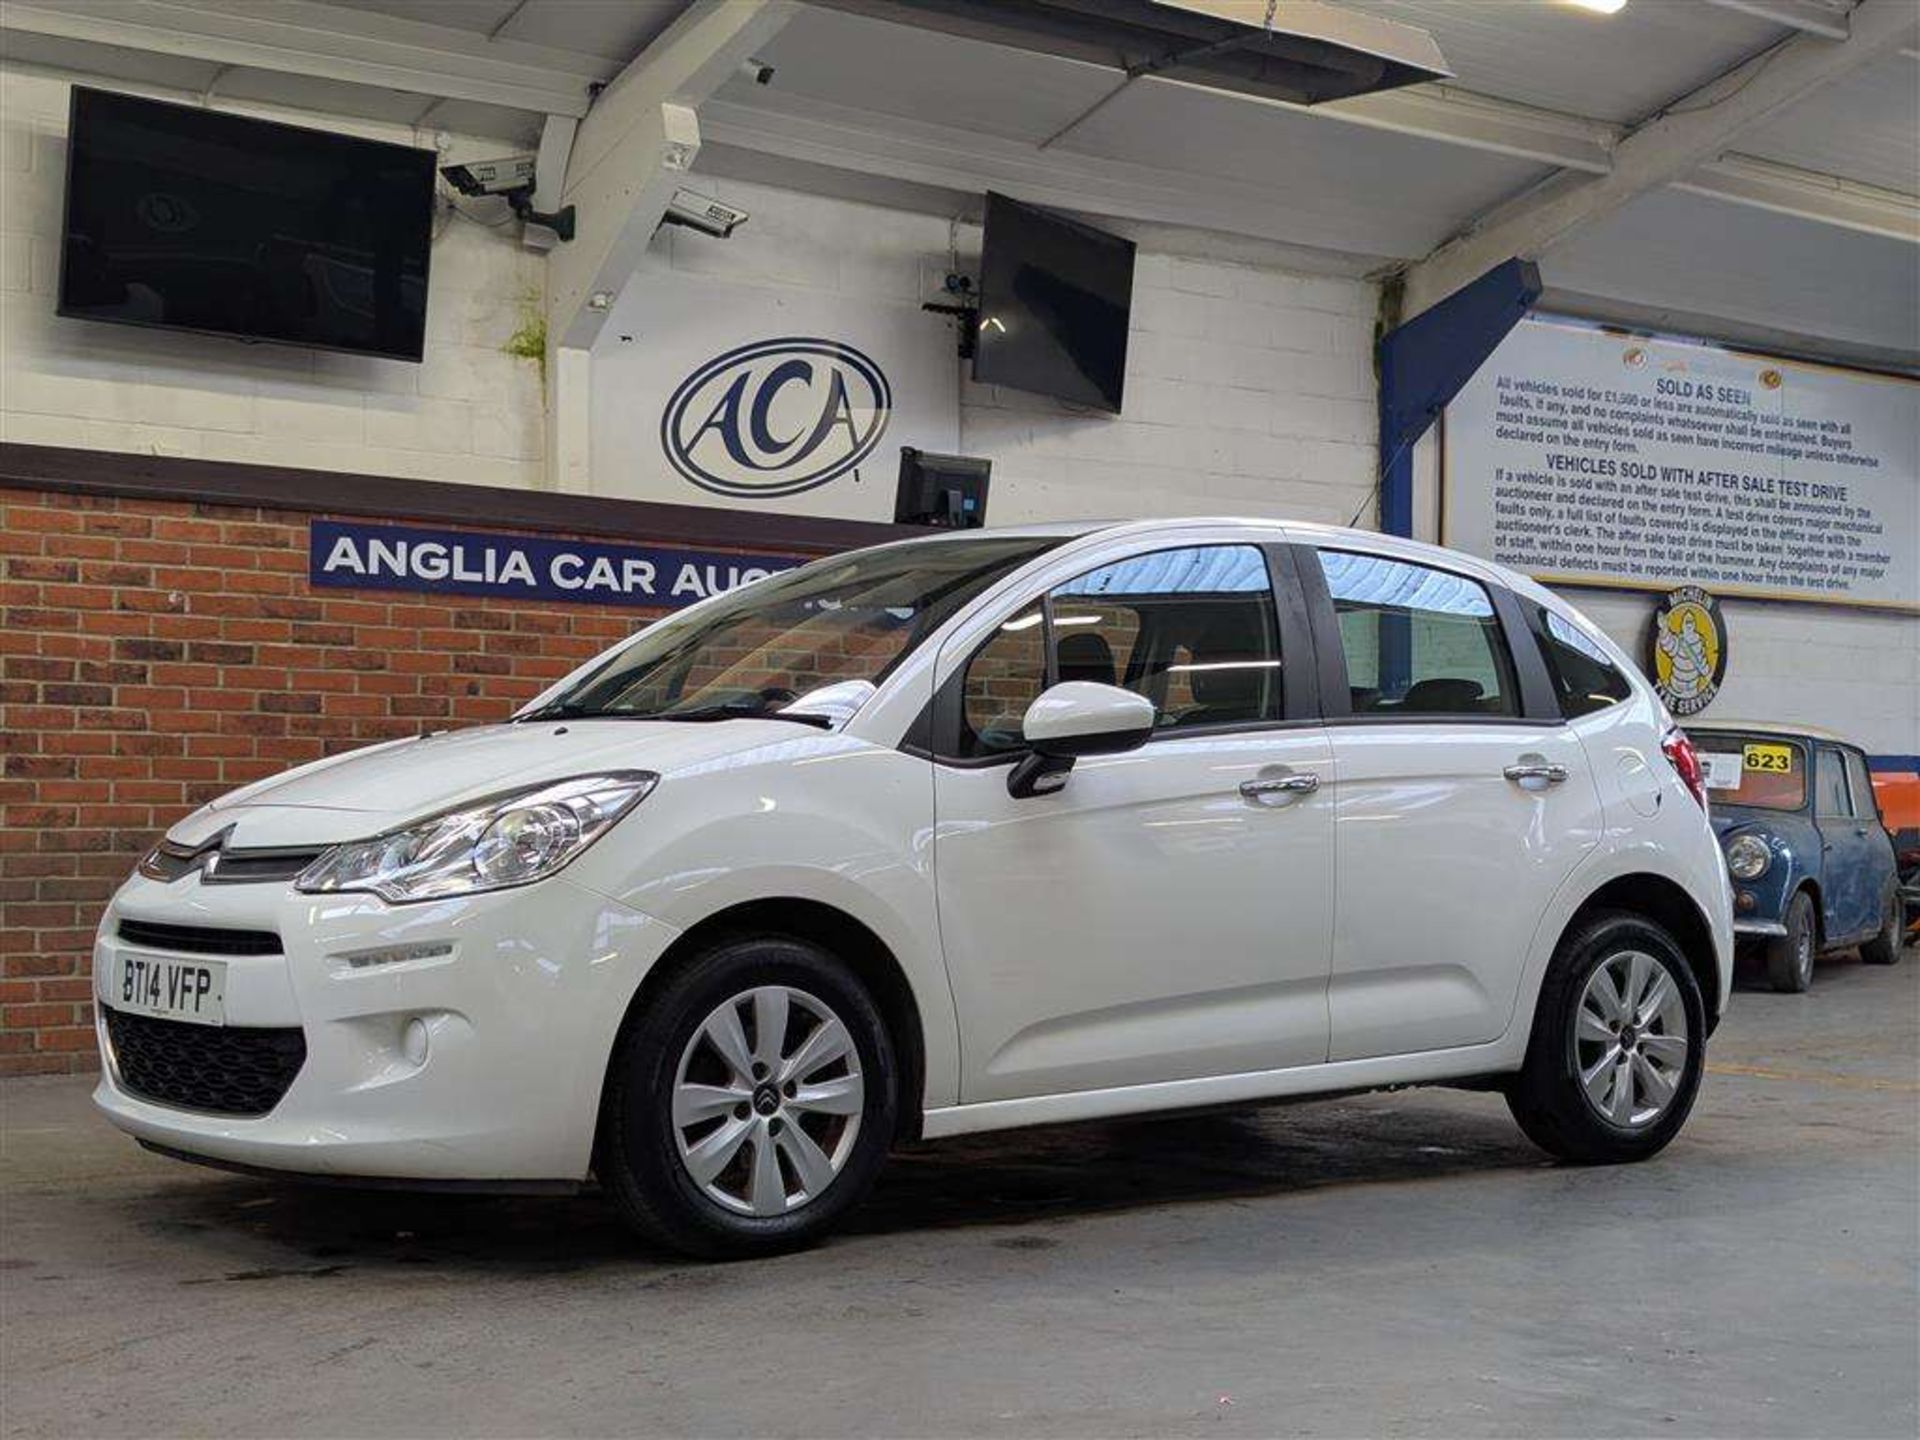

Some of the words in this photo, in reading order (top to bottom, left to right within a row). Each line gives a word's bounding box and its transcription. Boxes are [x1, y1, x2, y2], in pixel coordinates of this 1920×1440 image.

[1514, 380, 1557, 395] vehicles
[1561, 386, 1584, 399] sold
[1587, 388, 1601, 401] for
[1640, 398, 1651, 407] or
[1654, 397, 1673, 410] less
[1676, 403, 1691, 413] are
[1656, 377, 1692, 397] SOLD
[1696, 385, 1714, 401] AS
[1717, 387, 1751, 405] SEEN
[685, 360, 858, 471] ACA
[1496, 412, 1523, 423] must
[1526, 415, 1567, 429] assume
[1571, 419, 1584, 431] all
[1586, 422, 1629, 436] vehicles
[1633, 428, 1654, 439] sold
[1656, 432, 1668, 441] as
[1670, 434, 1694, 444] seen
[1697, 434, 1718, 447] have
[1721, 437, 1763, 453] incorrect
[1570, 403, 1590, 416] and
[1594, 407, 1606, 418] no
[1609, 409, 1664, 425] complaints
[1751, 425, 1761, 437] be
[1496, 425, 1543, 442] declared
[1546, 434, 1559, 444] on
[1563, 433, 1580, 446] the
[1582, 437, 1609, 452] entry
[1496, 468, 1503, 480] If
[1515, 472, 1553, 485] vehicle
[1556, 475, 1566, 486] is
[1569, 477, 1592, 489] sold
[1594, 480, 1616, 491] with
[1620, 484, 1631, 493] an
[1634, 483, 1656, 496] after
[1660, 487, 1680, 498] sale
[1683, 488, 1702, 500] test
[1734, 494, 1750, 505] this
[1779, 498, 1790, 509] be
[1546, 454, 1615, 476] VEHICLES
[1620, 462, 1656, 480] SOLD
[1660, 466, 1693, 484] WITH
[1696, 470, 1738, 489] AFTER
[1742, 476, 1774, 493] SALE
[1778, 480, 1808, 497] TEST
[1812, 484, 1846, 501] DRIVE
[1496, 487, 1552, 501] auctioneer
[1556, 492, 1574, 503] and
[1578, 493, 1624, 508] declared
[1627, 501, 1638, 510] on
[1642, 500, 1657, 511] the
[1660, 503, 1685, 517] entry
[1725, 508, 1743, 520] test
[1746, 510, 1768, 522] drive
[1772, 515, 1803, 526] covers
[1496, 500, 1525, 515] faults
[1566, 507, 1583, 520] full
[1586, 509, 1601, 522] list
[1604, 511, 1615, 523] of
[1618, 512, 1646, 526] faults
[1649, 518, 1688, 530] covered
[1690, 519, 1699, 531] is
[1702, 520, 1747, 537] displayed
[1751, 525, 1759, 537] in
[1762, 526, 1776, 538] the
[1495, 535, 1505, 546] of
[1540, 539, 1571, 551] within
[1574, 543, 1594, 553] one
[1597, 543, 1620, 555] hour
[1623, 545, 1646, 557] from
[1649, 547, 1665, 559] the
[1668, 549, 1683, 560] fall
[1685, 551, 1695, 561] of
[1698, 551, 1712, 563] the
[1758, 556, 1776, 571] Any
[1778, 560, 1828, 573] complaints
[1830, 563, 1839, 573] of
[1596, 527, 1616, 539] The
[1618, 529, 1640, 541] after
[1644, 532, 1664, 543] sale
[1666, 533, 1686, 545] test
[1688, 535, 1712, 547] drive
[1715, 539, 1738, 550] must
[1741, 540, 1753, 551] be
[323, 537, 536, 586] ANGLIA
[549, 553, 656, 595] CAR
[670, 563, 778, 599] AU
[1495, 552, 1556, 566] mechanical
[1560, 556, 1598, 569] defects
[1645, 565, 1687, 577] reported
[1746, 752, 1789, 770] 623
[123, 959, 161, 1006] BT14
[168, 965, 211, 1013] VFP
